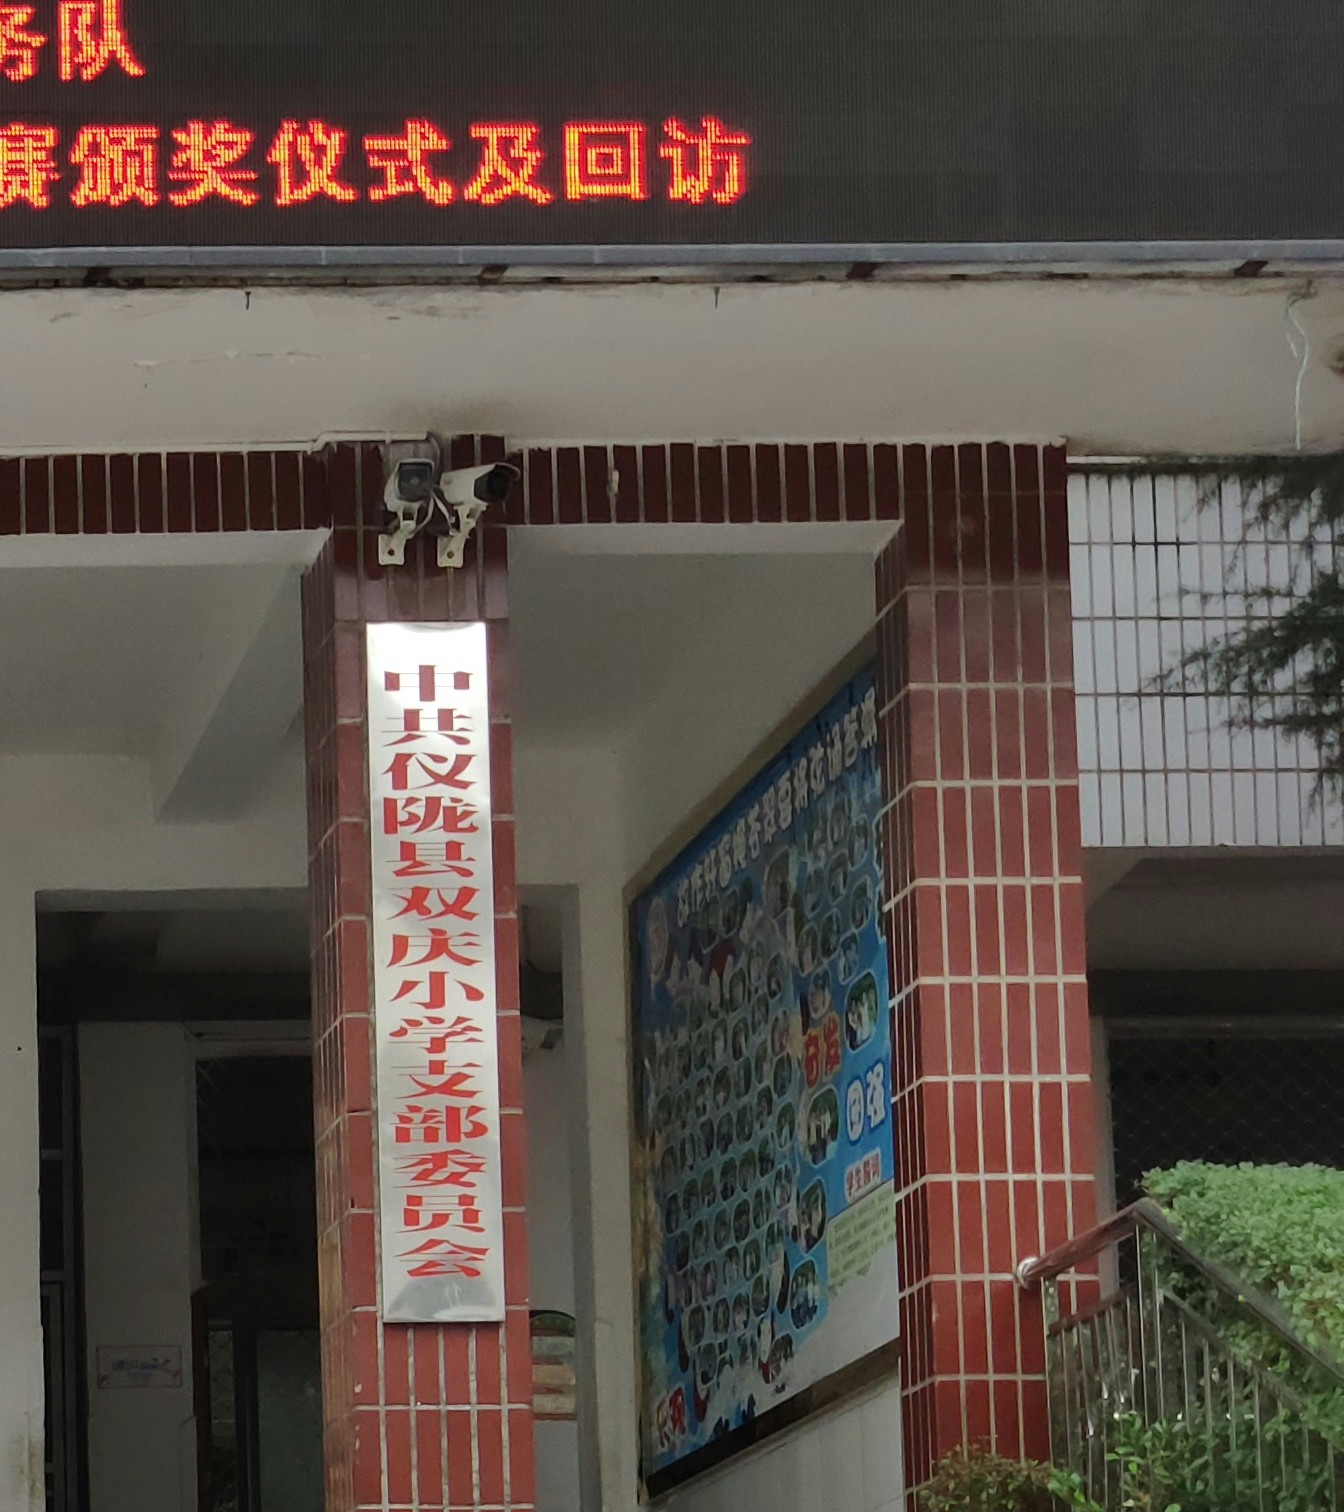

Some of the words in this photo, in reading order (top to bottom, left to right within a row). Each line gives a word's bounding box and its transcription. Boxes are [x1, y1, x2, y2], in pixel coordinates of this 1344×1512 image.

[381, 663, 490, 1278] 中共仪陇县双庆小学支部委员会
